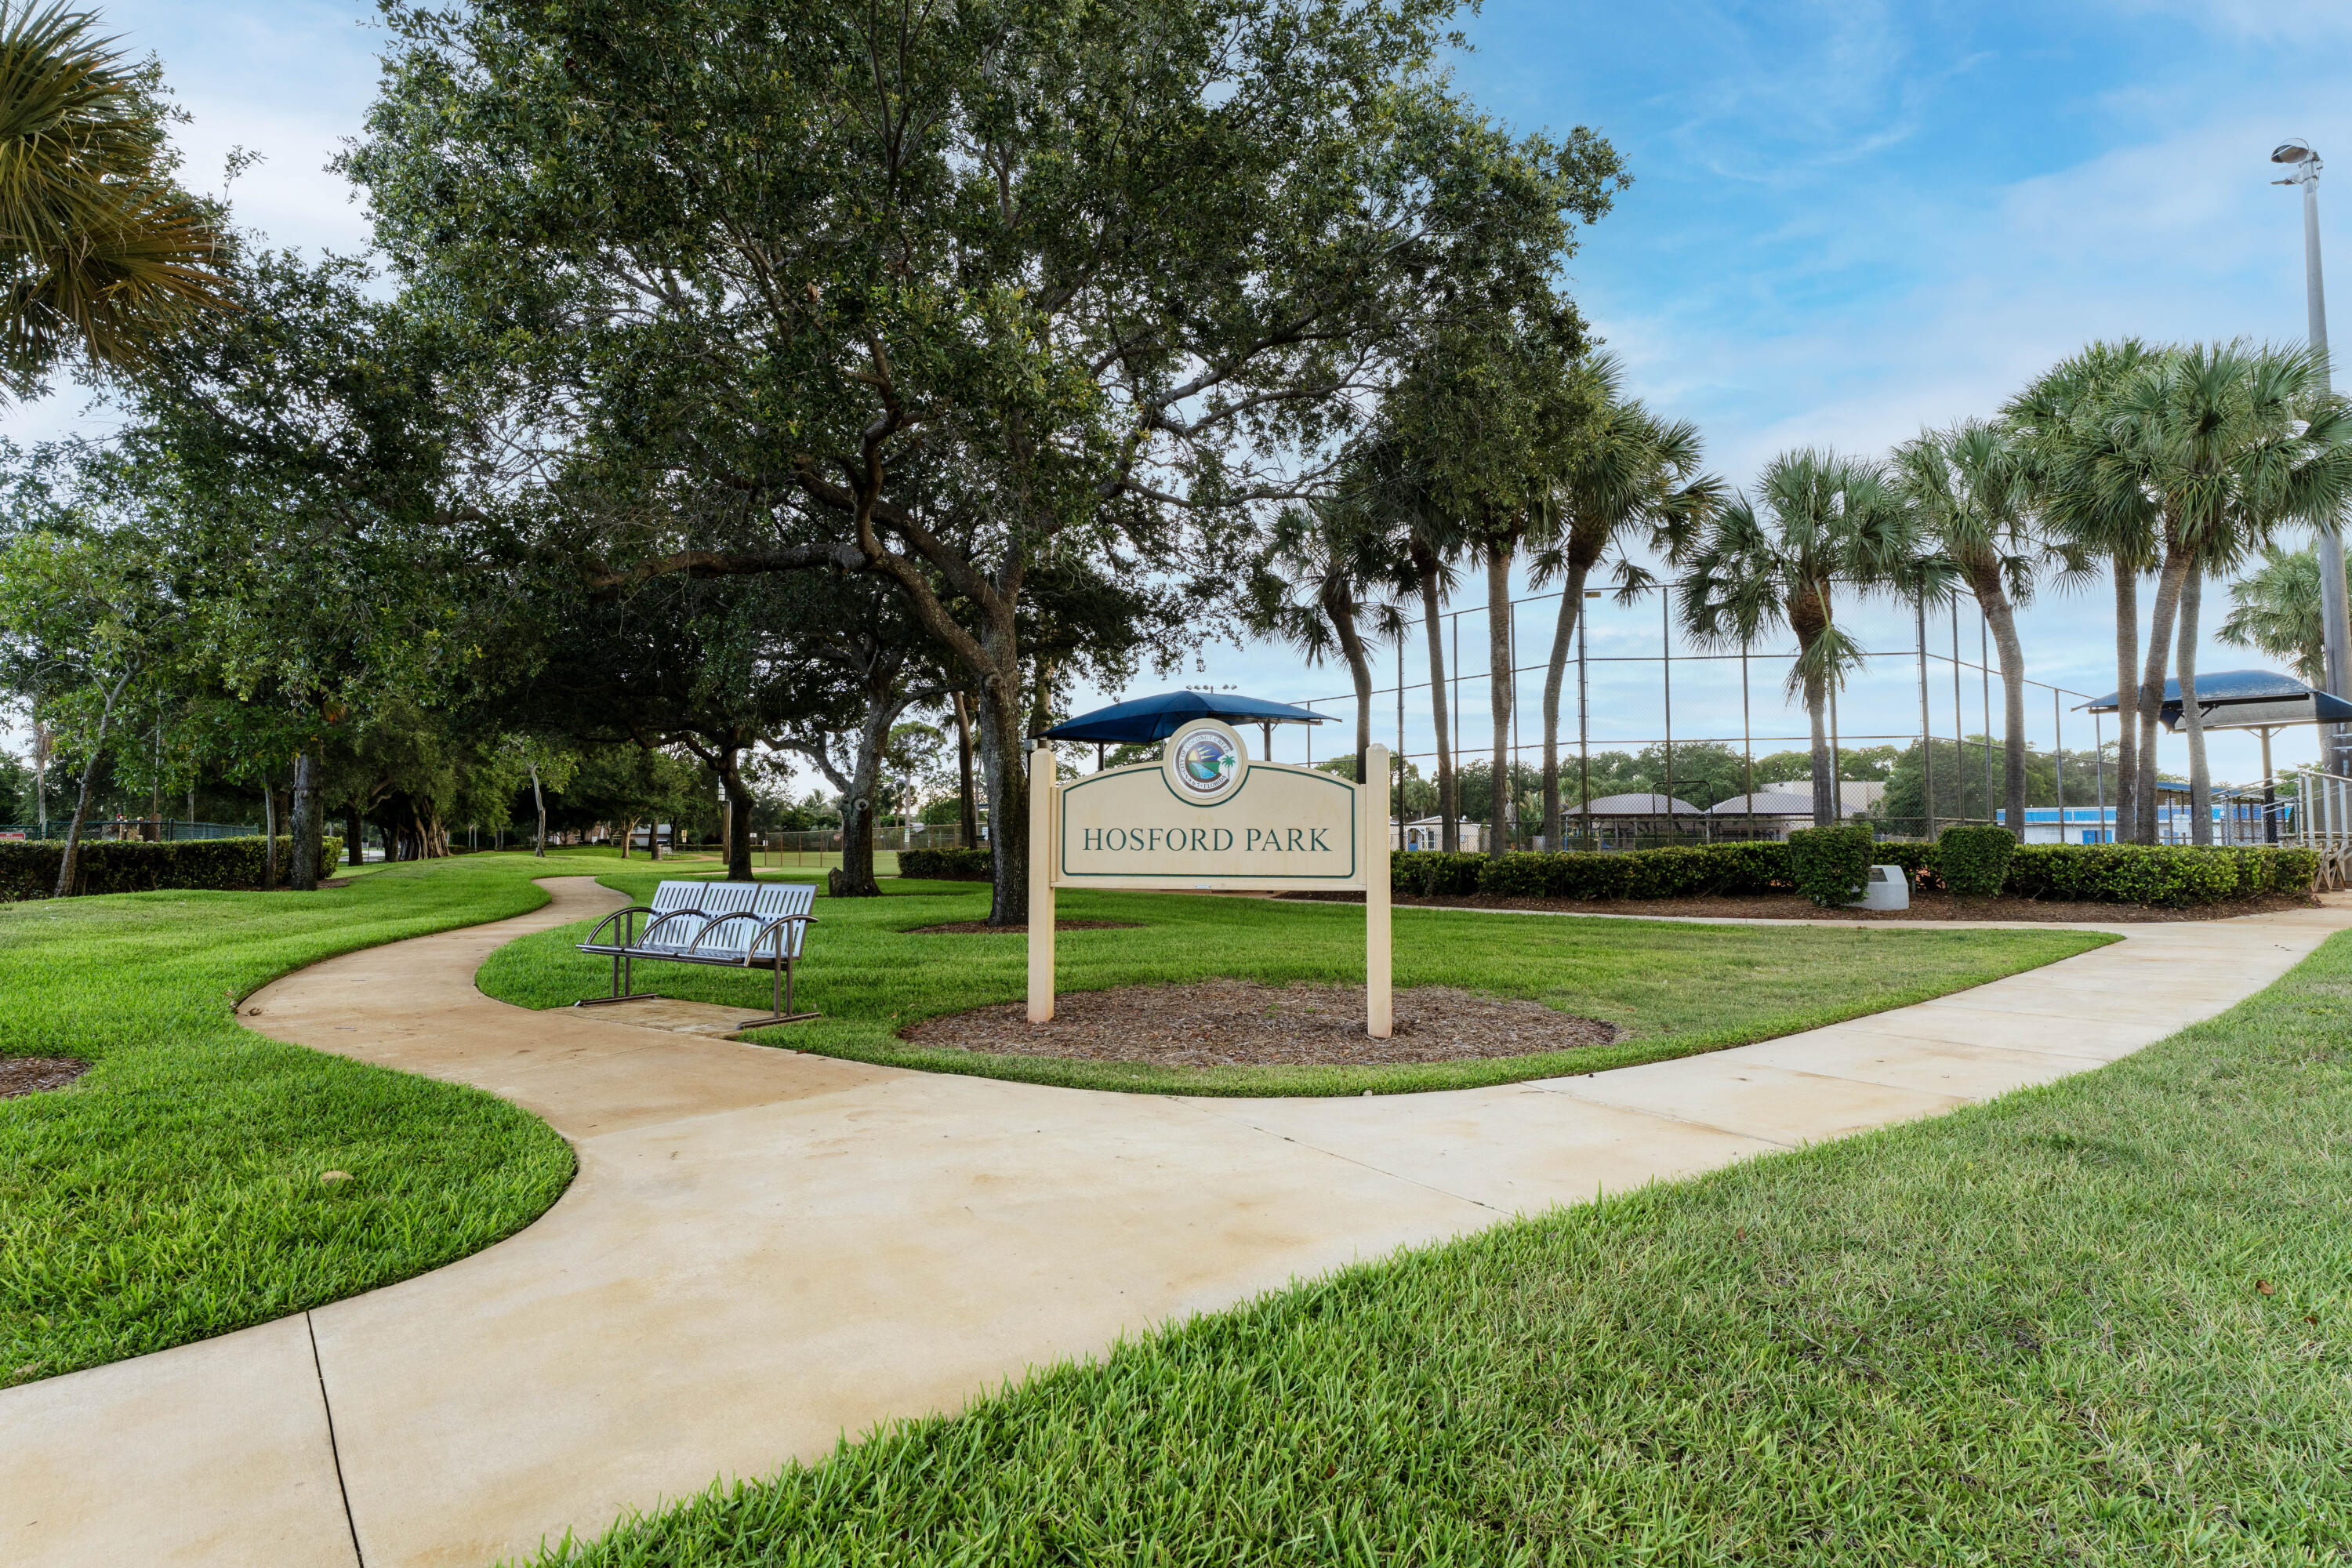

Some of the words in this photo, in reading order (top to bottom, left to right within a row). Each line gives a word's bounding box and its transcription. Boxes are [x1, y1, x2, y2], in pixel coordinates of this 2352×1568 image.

[1185, 735, 1212, 750] COCONUT
[1214, 737, 1230, 753] CREEK
[1185, 775, 1200, 787] 1967
[1203, 775, 1227, 789] FLORIDA
[1083, 827, 1234, 851] HOSFORD
[1245, 827, 1332, 852] PARK
